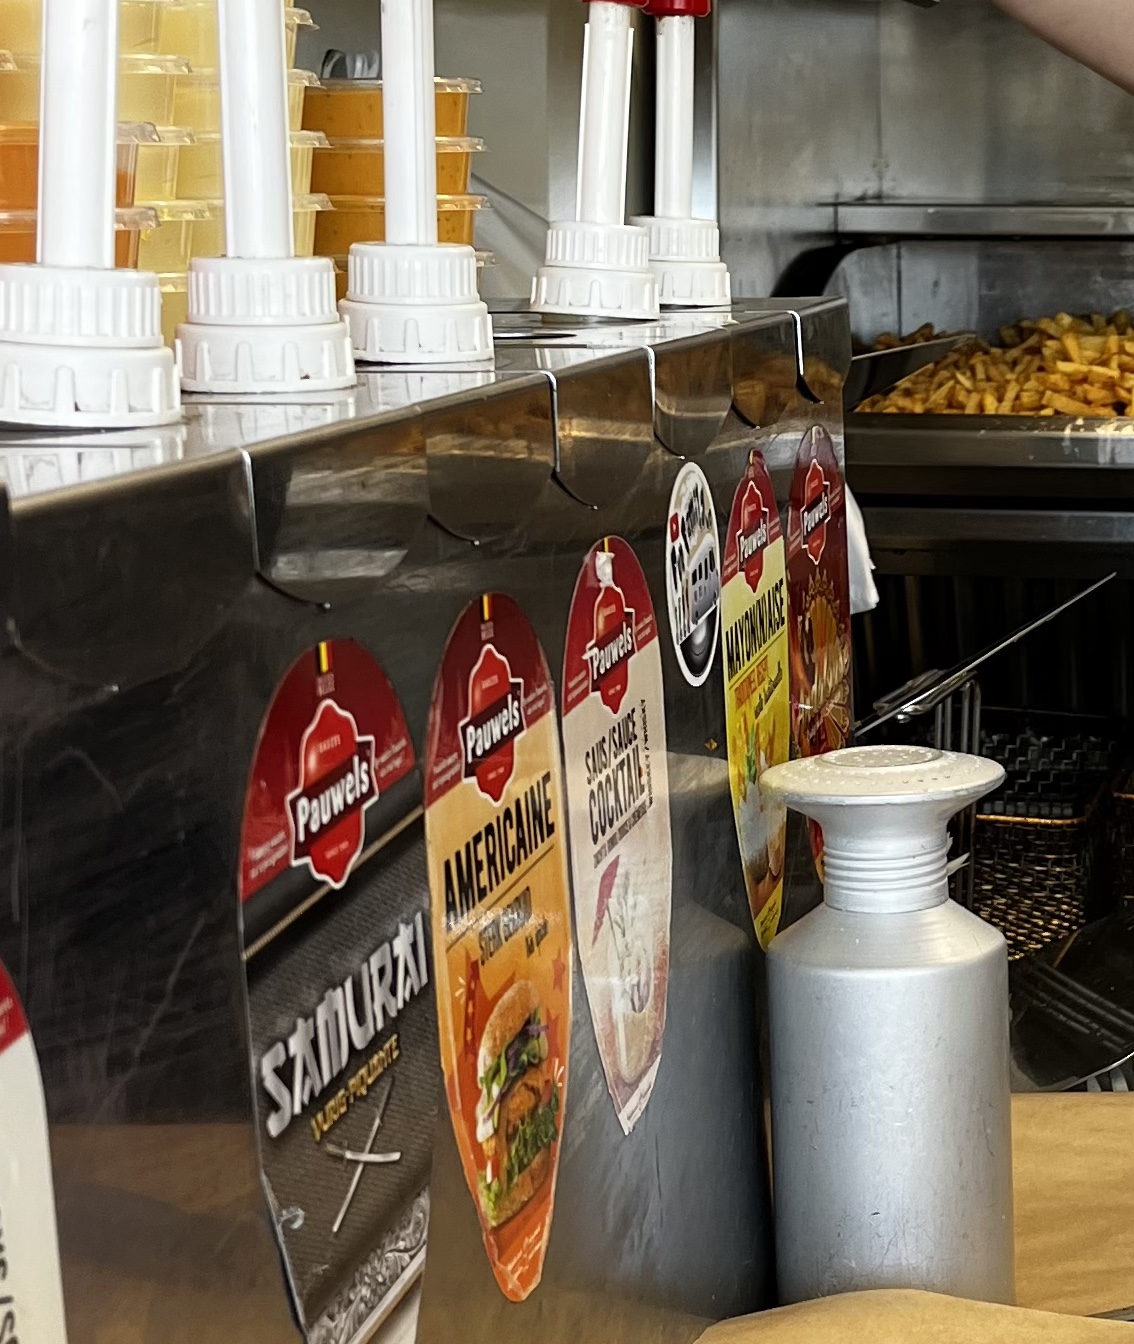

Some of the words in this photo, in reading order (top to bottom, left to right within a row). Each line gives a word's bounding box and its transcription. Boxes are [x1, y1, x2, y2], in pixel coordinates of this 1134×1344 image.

[740, 518, 767, 563] Pauwels
[803, 491, 828, 536] Pauwels
[592, 621, 633, 680] Pauwels
[466, 693, 520, 764] Pauwels
[296, 754, 370, 843] Pauwels
[588, 743, 646, 846] COCKTAIL
[443, 770, 556, 936] AMERICAINE
[261, 911, 429, 1139] SAMURAI
